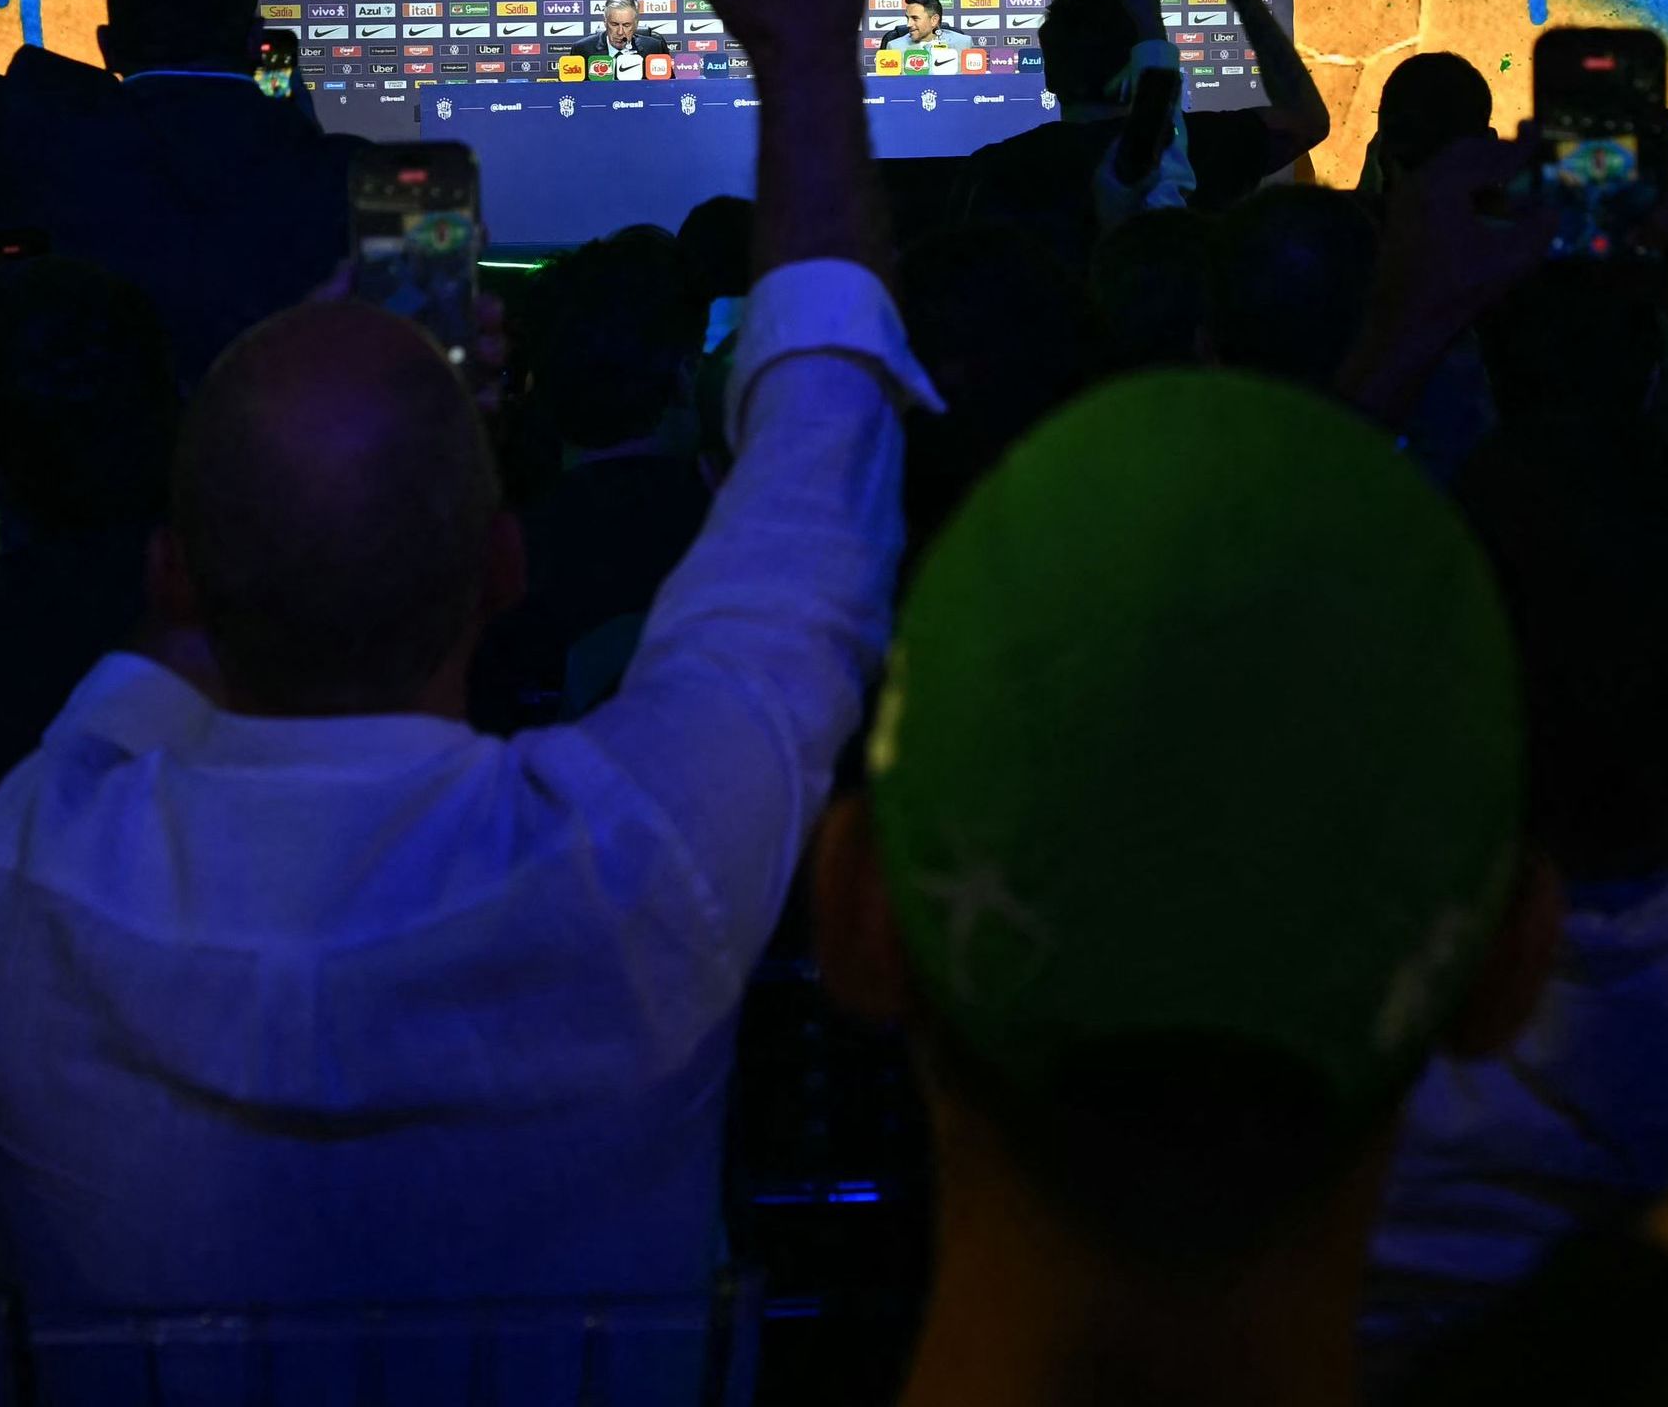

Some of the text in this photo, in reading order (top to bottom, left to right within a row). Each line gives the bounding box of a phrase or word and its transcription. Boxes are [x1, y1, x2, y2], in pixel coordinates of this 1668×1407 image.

[359, 7, 381, 15] Azul
[412, 5, 434, 16] itaú
[506, 4, 528, 14] Sadia
[548, 4, 570, 13] vivo
[646, 2, 668, 12] itaú
[269, 7, 292, 17] Sadia
[312, 7, 335, 16] vivo
[1007, 37, 1027, 45] Uber
[1214, 33, 1234, 42] Uber
[301, 48, 321, 56] Uber
[480, 45, 500, 53] Uber
[1022, 57, 1041, 65] Azul
[373, 64, 393, 72] Uber
[707, 62, 726, 70] Azul
[974, 96, 1004, 104] @brasil
[490, 103, 521, 112] @brasil
[613, 101, 643, 109] @brasil
